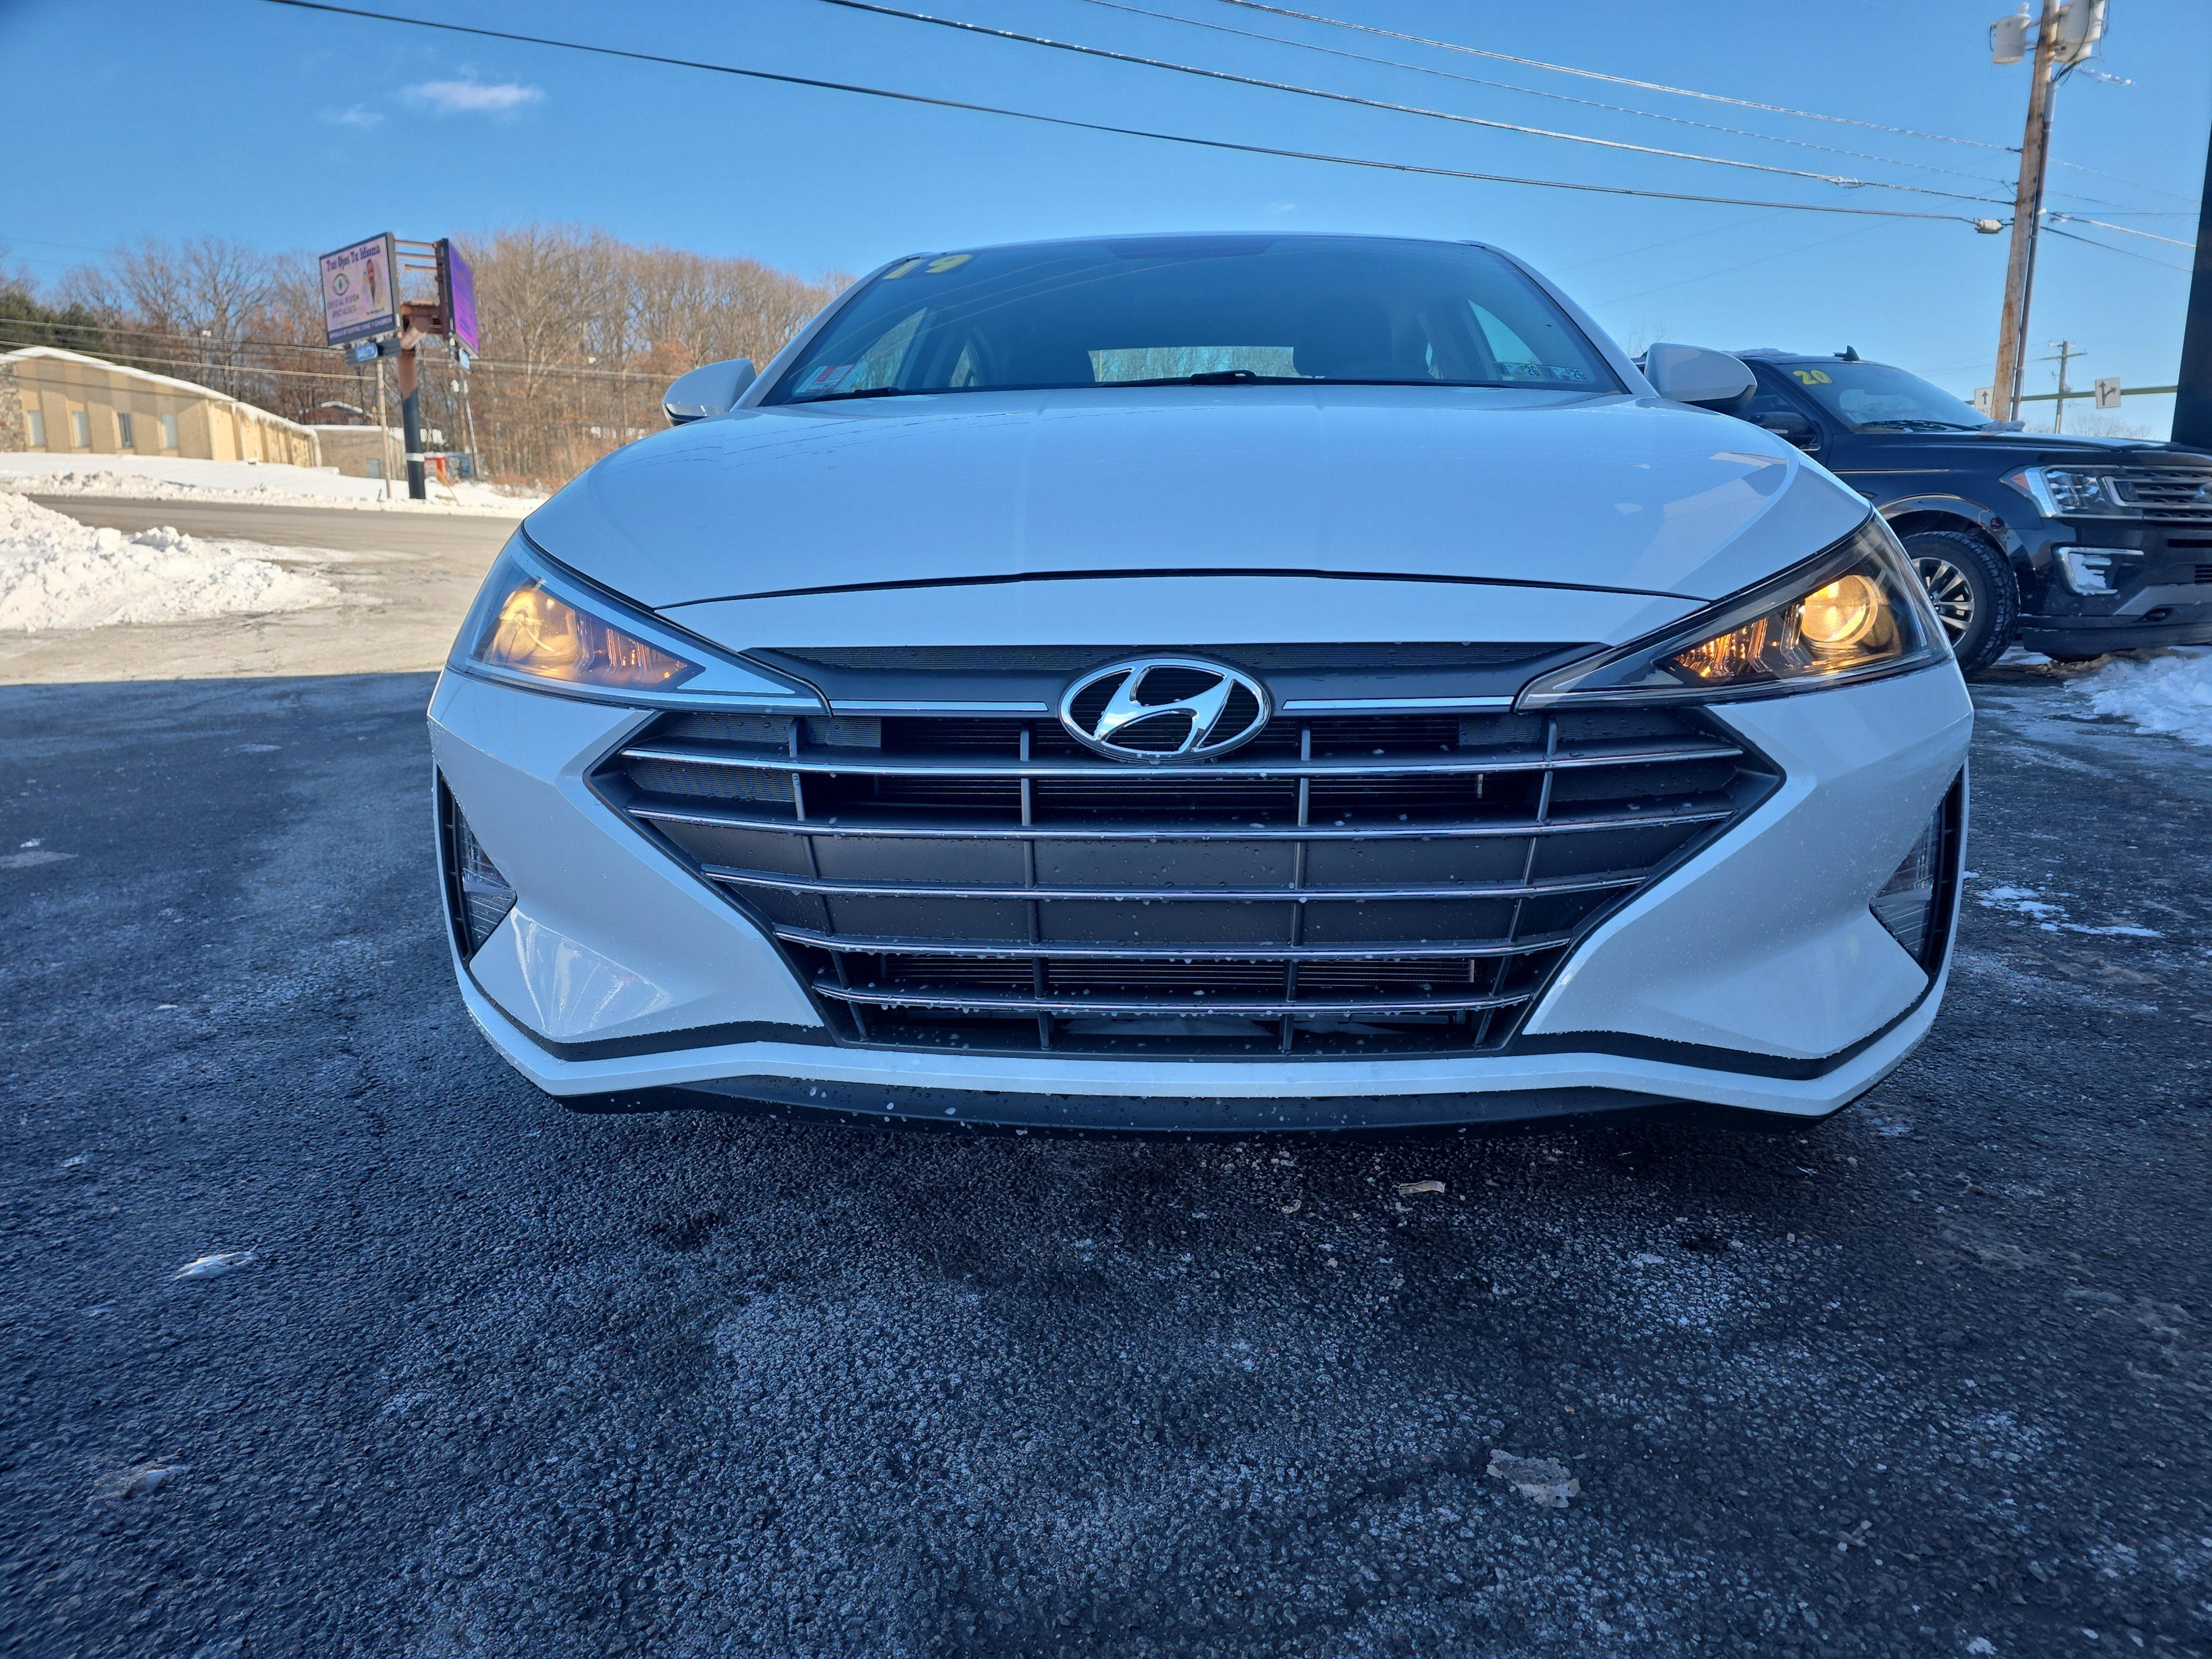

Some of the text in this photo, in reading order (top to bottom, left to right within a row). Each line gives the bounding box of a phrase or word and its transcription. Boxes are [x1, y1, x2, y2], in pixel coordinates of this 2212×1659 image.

[360, 245, 381, 259] Idioma
[883, 254, 974, 280] 19
[1526, 364, 1540, 376] 26
[1571, 368, 1586, 380] 26
[1792, 369, 1832, 385] 20
